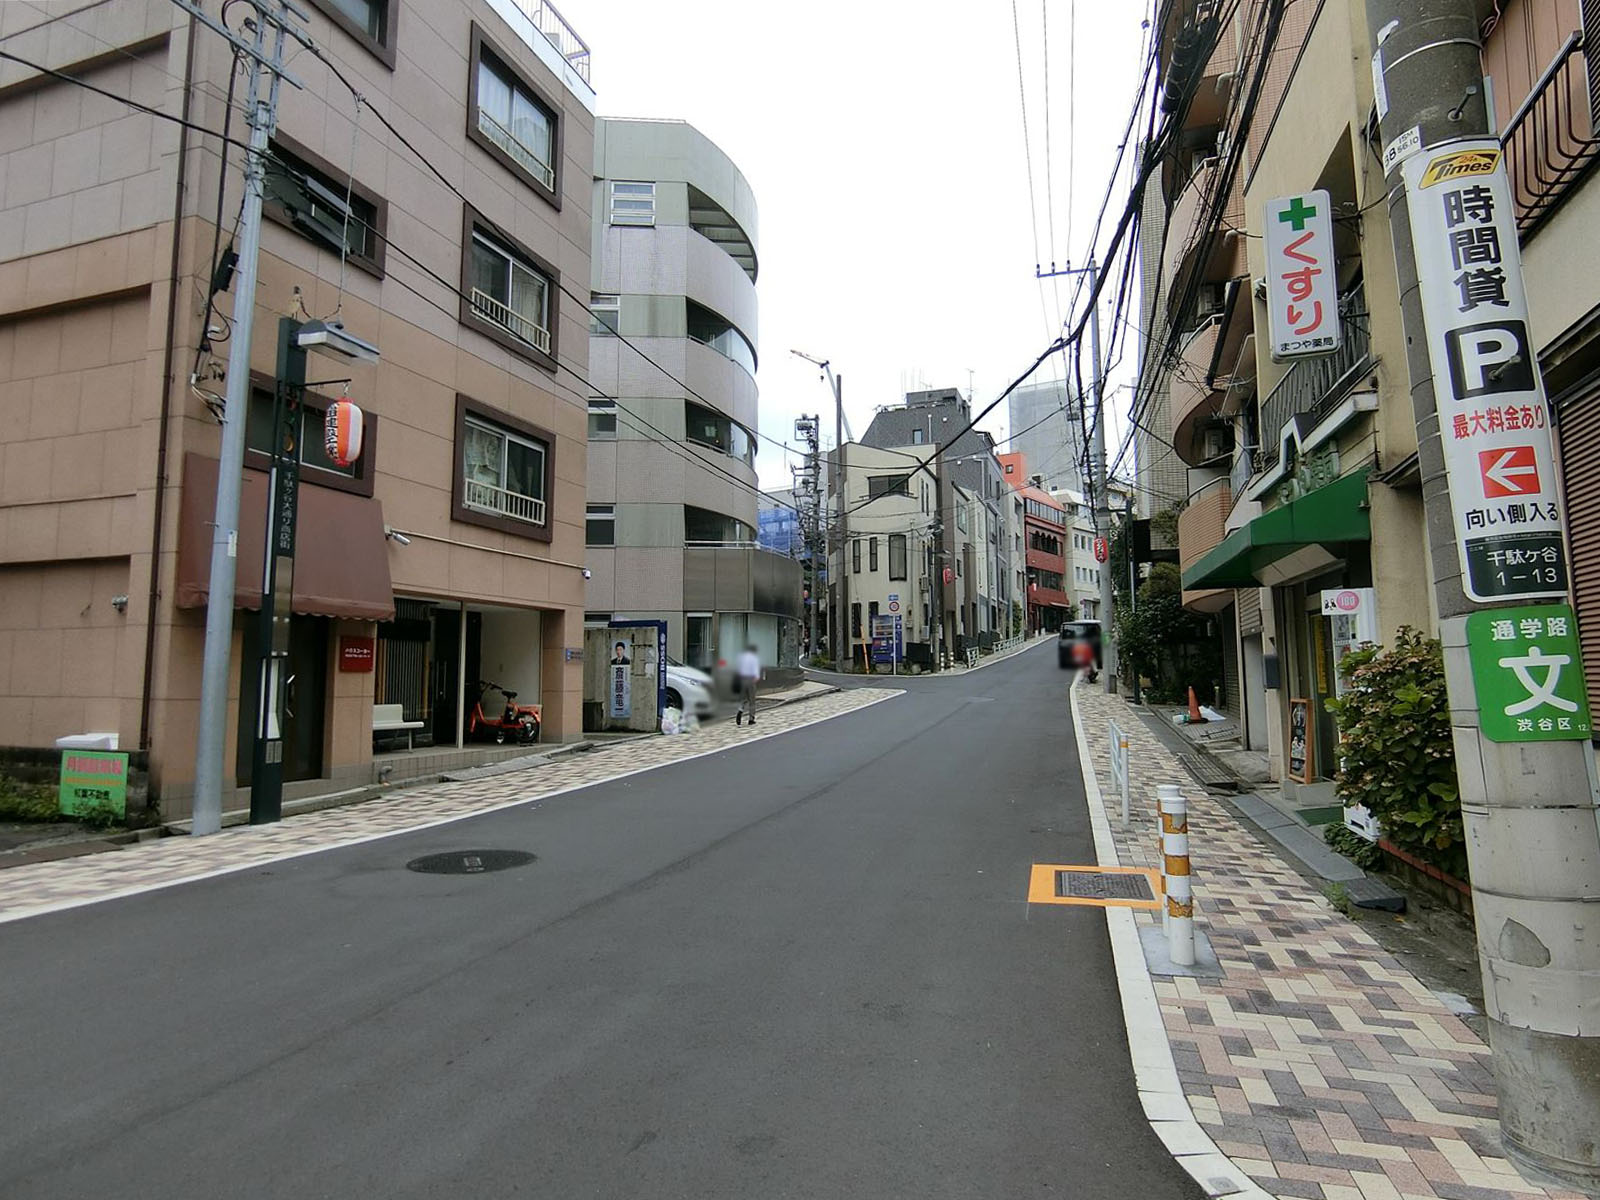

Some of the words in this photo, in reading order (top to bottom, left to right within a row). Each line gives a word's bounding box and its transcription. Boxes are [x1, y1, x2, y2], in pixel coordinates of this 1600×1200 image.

[1433, 162, 1492, 181] Times
[1443, 184, 1510, 313] 時間貸
[1282, 231, 1323, 336] くすり
[1280, 337, 1334, 351] まつや薬局
[1459, 328, 1519, 391] P
[1453, 404, 1545, 440] 最大料金あり
[1465, 502, 1559, 530] 向い側入る
[1491, 617, 1567, 641] 通学路
[1498, 646, 1578, 716] 文
[1517, 717, 1571, 732] 渋谷区
